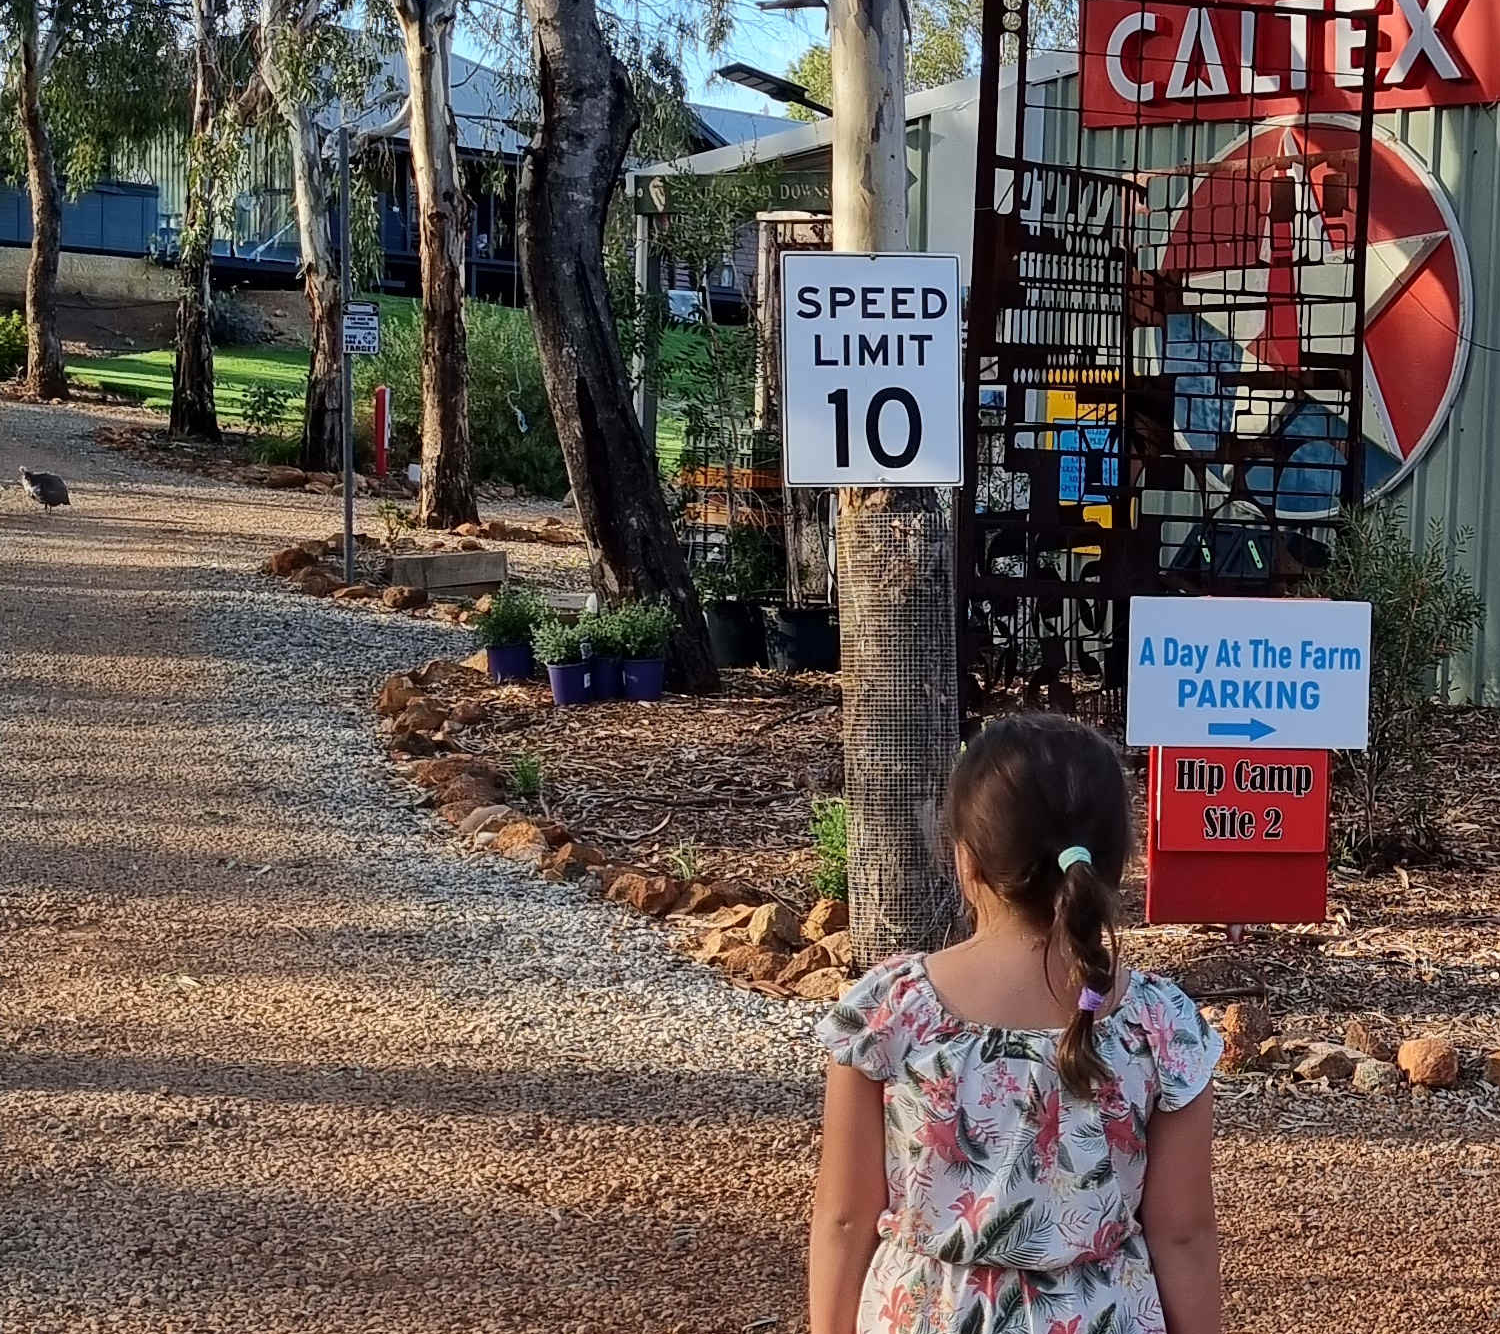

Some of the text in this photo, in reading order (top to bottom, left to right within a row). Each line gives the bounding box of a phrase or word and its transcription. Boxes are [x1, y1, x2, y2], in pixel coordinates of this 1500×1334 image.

[796, 286, 948, 319] SPEED
[814, 334, 933, 366] LIMIT
[827, 386, 922, 469] 10
[1138, 637, 1361, 674] A Day At The Farm
[1177, 678, 1321, 710] PARKING
[1175, 758, 1314, 798] Hip Camp
[1203, 805, 1283, 840] Site 2
